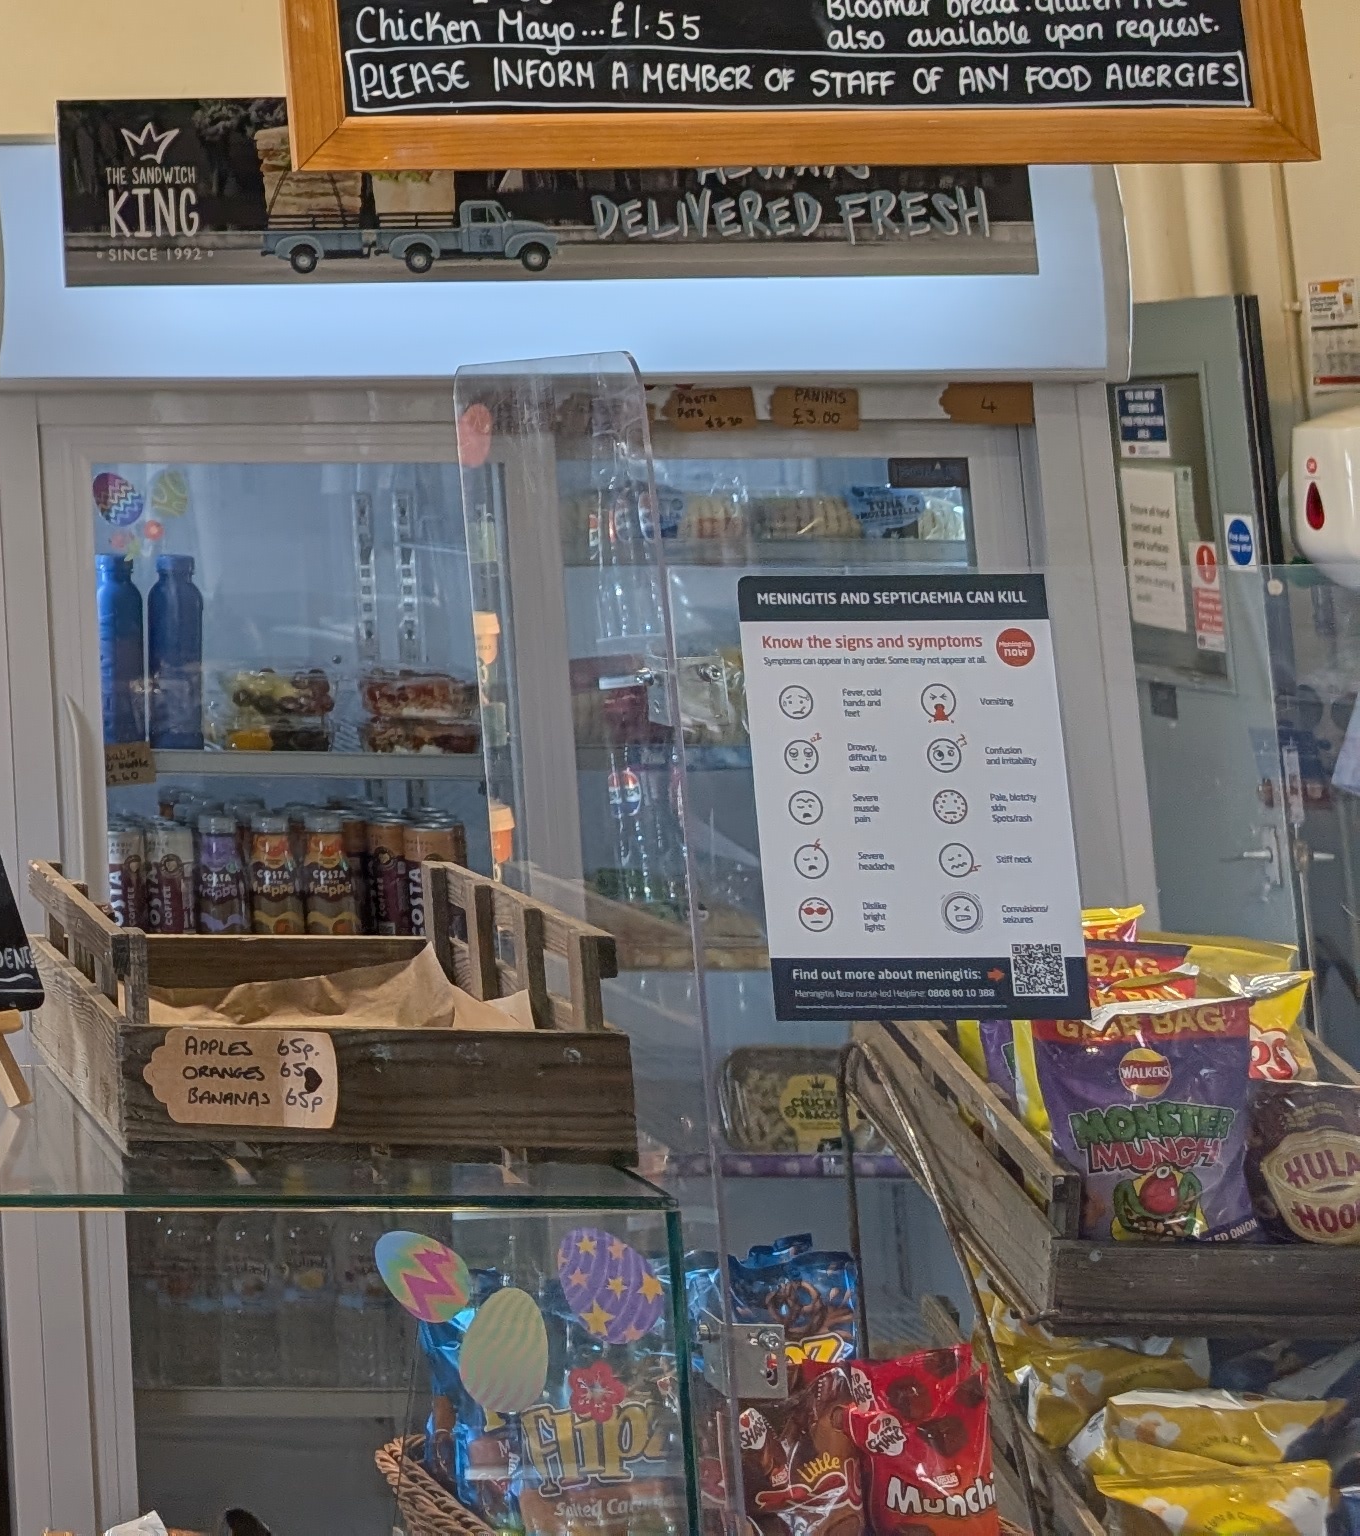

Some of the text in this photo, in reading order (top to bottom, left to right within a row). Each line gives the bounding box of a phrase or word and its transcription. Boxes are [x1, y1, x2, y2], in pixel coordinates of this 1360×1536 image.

[356, 2, 700, 43] Chicken £1.55
[828, 24, 885, 50] also
[908, 21, 1031, 48] available
[1045, 22, 1104, 50] upon
[360, 59, 469, 101] PLEASE
[494, 57, 594, 92] INFORM
[612, 62, 628, 89] A
[643, 63, 750, 91] MEMBER
[765, 66, 794, 91] OF
[812, 68, 895, 97] STAFF
[914, 67, 943, 93] OF
[959, 64, 1008, 94] ANY
[1026, 66, 1091, 94] FOOD
[106, 166, 195, 184] THE SANDWICH
[108, 187, 199, 238] KING
[591, 185, 990, 246] DELIVERED FRESH
[108, 248, 202, 261] SINCE 1992
[792, 408, 840, 425] £3.00
[757, 590, 1027, 605] MENINGITIS AND SEPTICAEMIA CAN KILL
[762, 635, 982, 651] Know the signs and symptoms
[793, 969, 818, 980] Find
[821, 969, 842, 980] out
[845, 970, 875, 980] more
[878, 969, 913, 980] about
[184, 1037, 254, 1057] APPLES
[182, 1065, 266, 1081] ORANGES
[1120, 1065, 1170, 1080] WALKERS
[187, 1087, 323, 1113] BANANAS 65p
[1069, 1101, 1234, 1148] MONSTER
[1088, 1138, 1222, 1174] MUNCH
